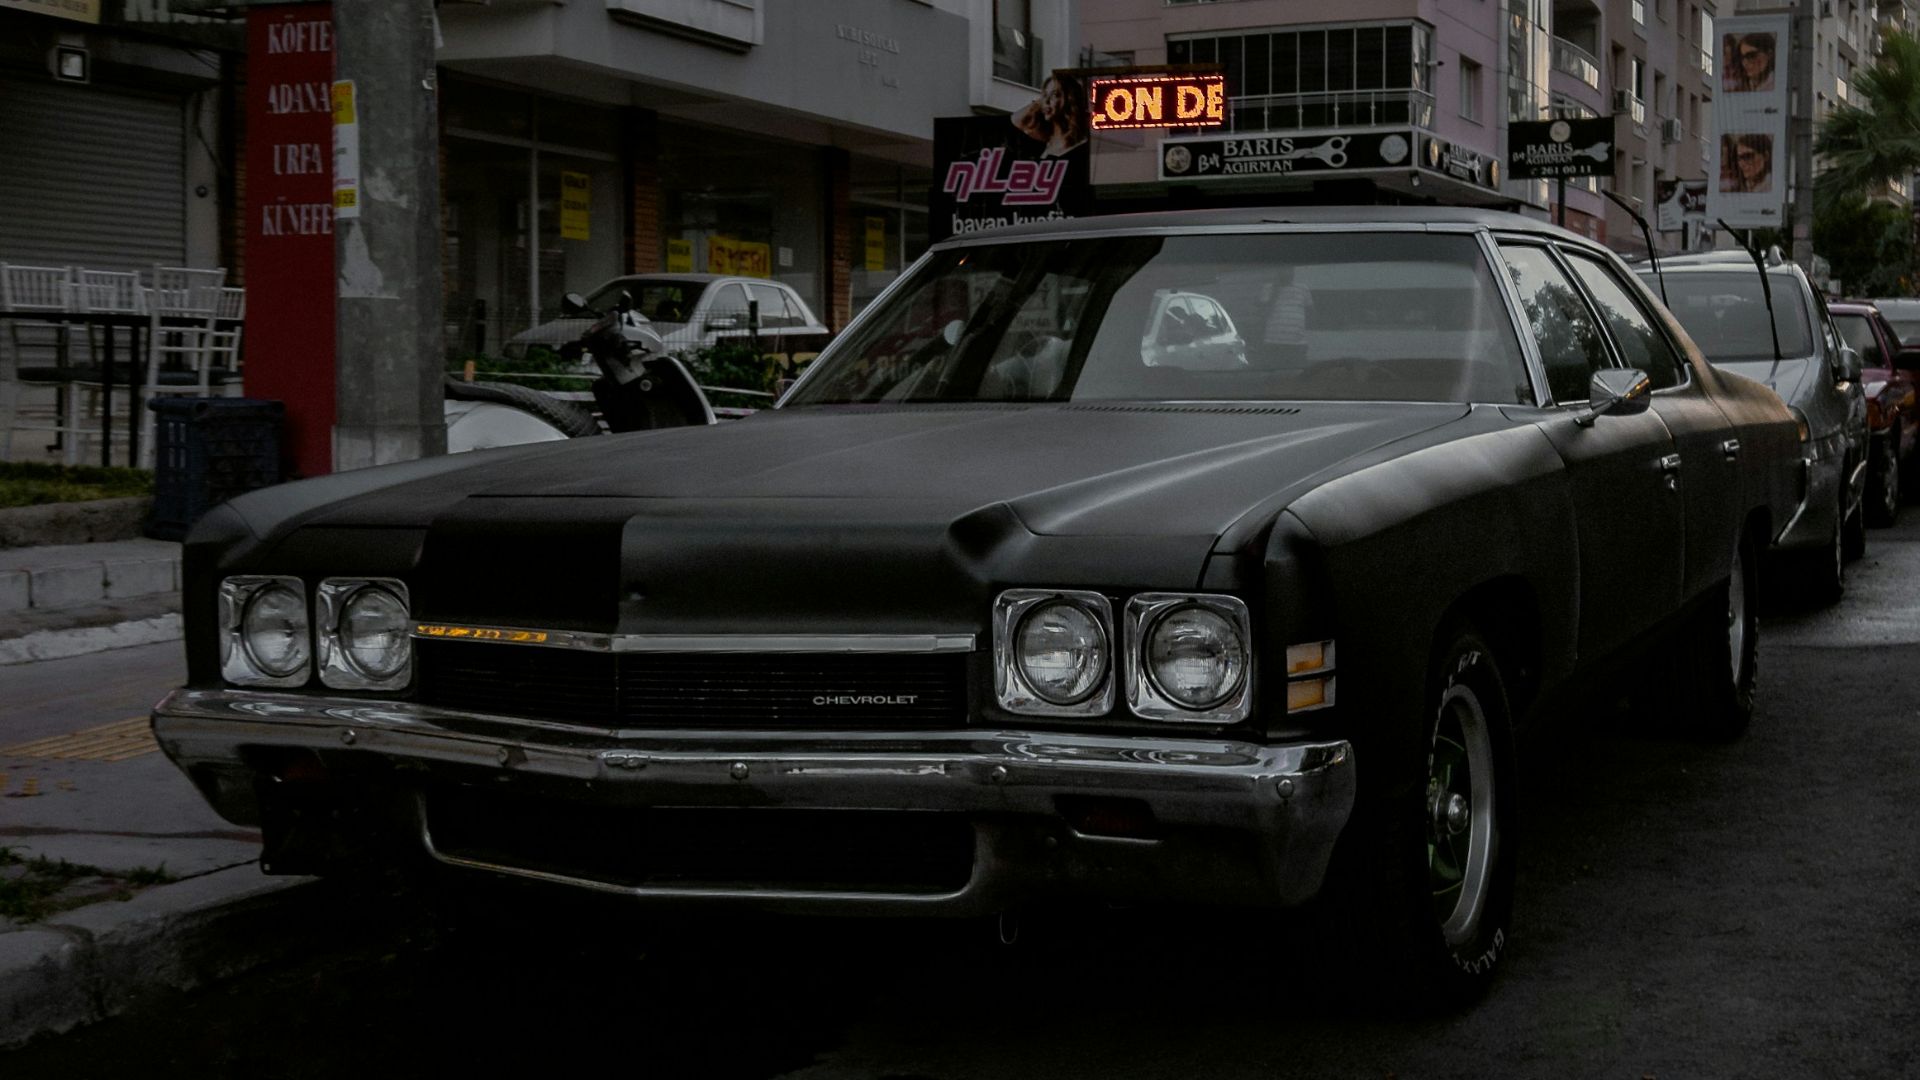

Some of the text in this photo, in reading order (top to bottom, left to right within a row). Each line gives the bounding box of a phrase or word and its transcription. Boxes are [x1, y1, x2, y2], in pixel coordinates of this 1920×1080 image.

[267, 14, 332, 54] KÖFTE
[265, 82, 332, 114] ADANA
[273, 142, 324, 176] URFA
[261, 196, 333, 236] KÜNEFE
[812, 695, 919, 706] CHEVROLET
